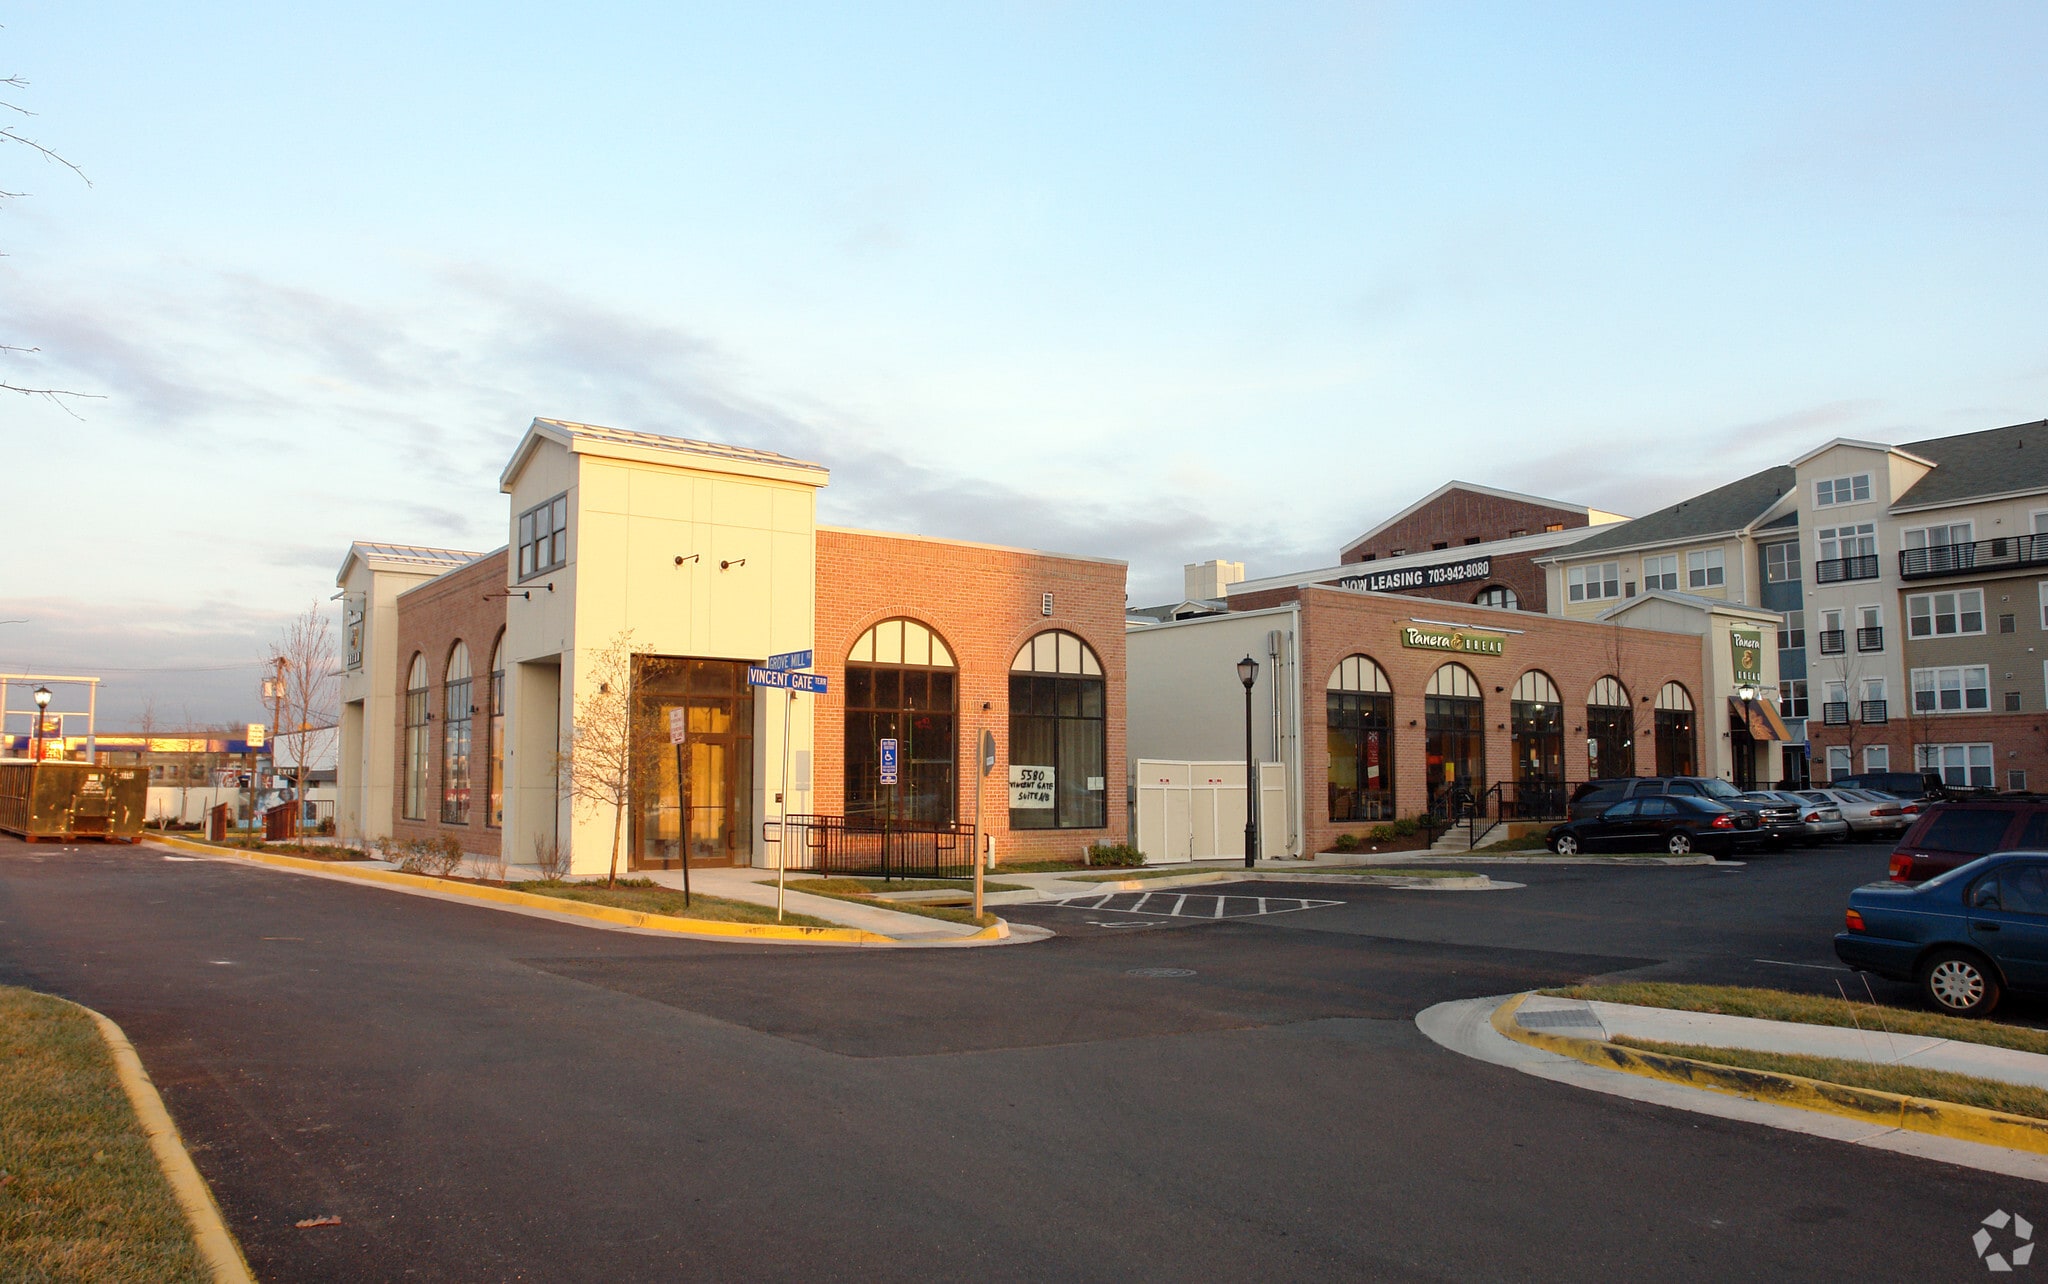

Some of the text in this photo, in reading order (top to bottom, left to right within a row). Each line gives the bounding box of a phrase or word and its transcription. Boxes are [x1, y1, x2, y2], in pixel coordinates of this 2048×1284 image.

[1371, 570, 1423, 590] LEASING
[1428, 561, 1489, 583] 703-942-8080
[1407, 628, 1502, 652] Panera BREAD
[1733, 633, 1760, 649] Panera
[769, 655, 789, 670] GROVE
[791, 652, 806, 668] MILL
[750, 668, 789, 686] VINCENT
[792, 674, 814, 690] GATE
[1020, 769, 1045, 781] 5580
[1036, 782, 1054, 790] GATE
[1018, 791, 1038, 801] SUITE
